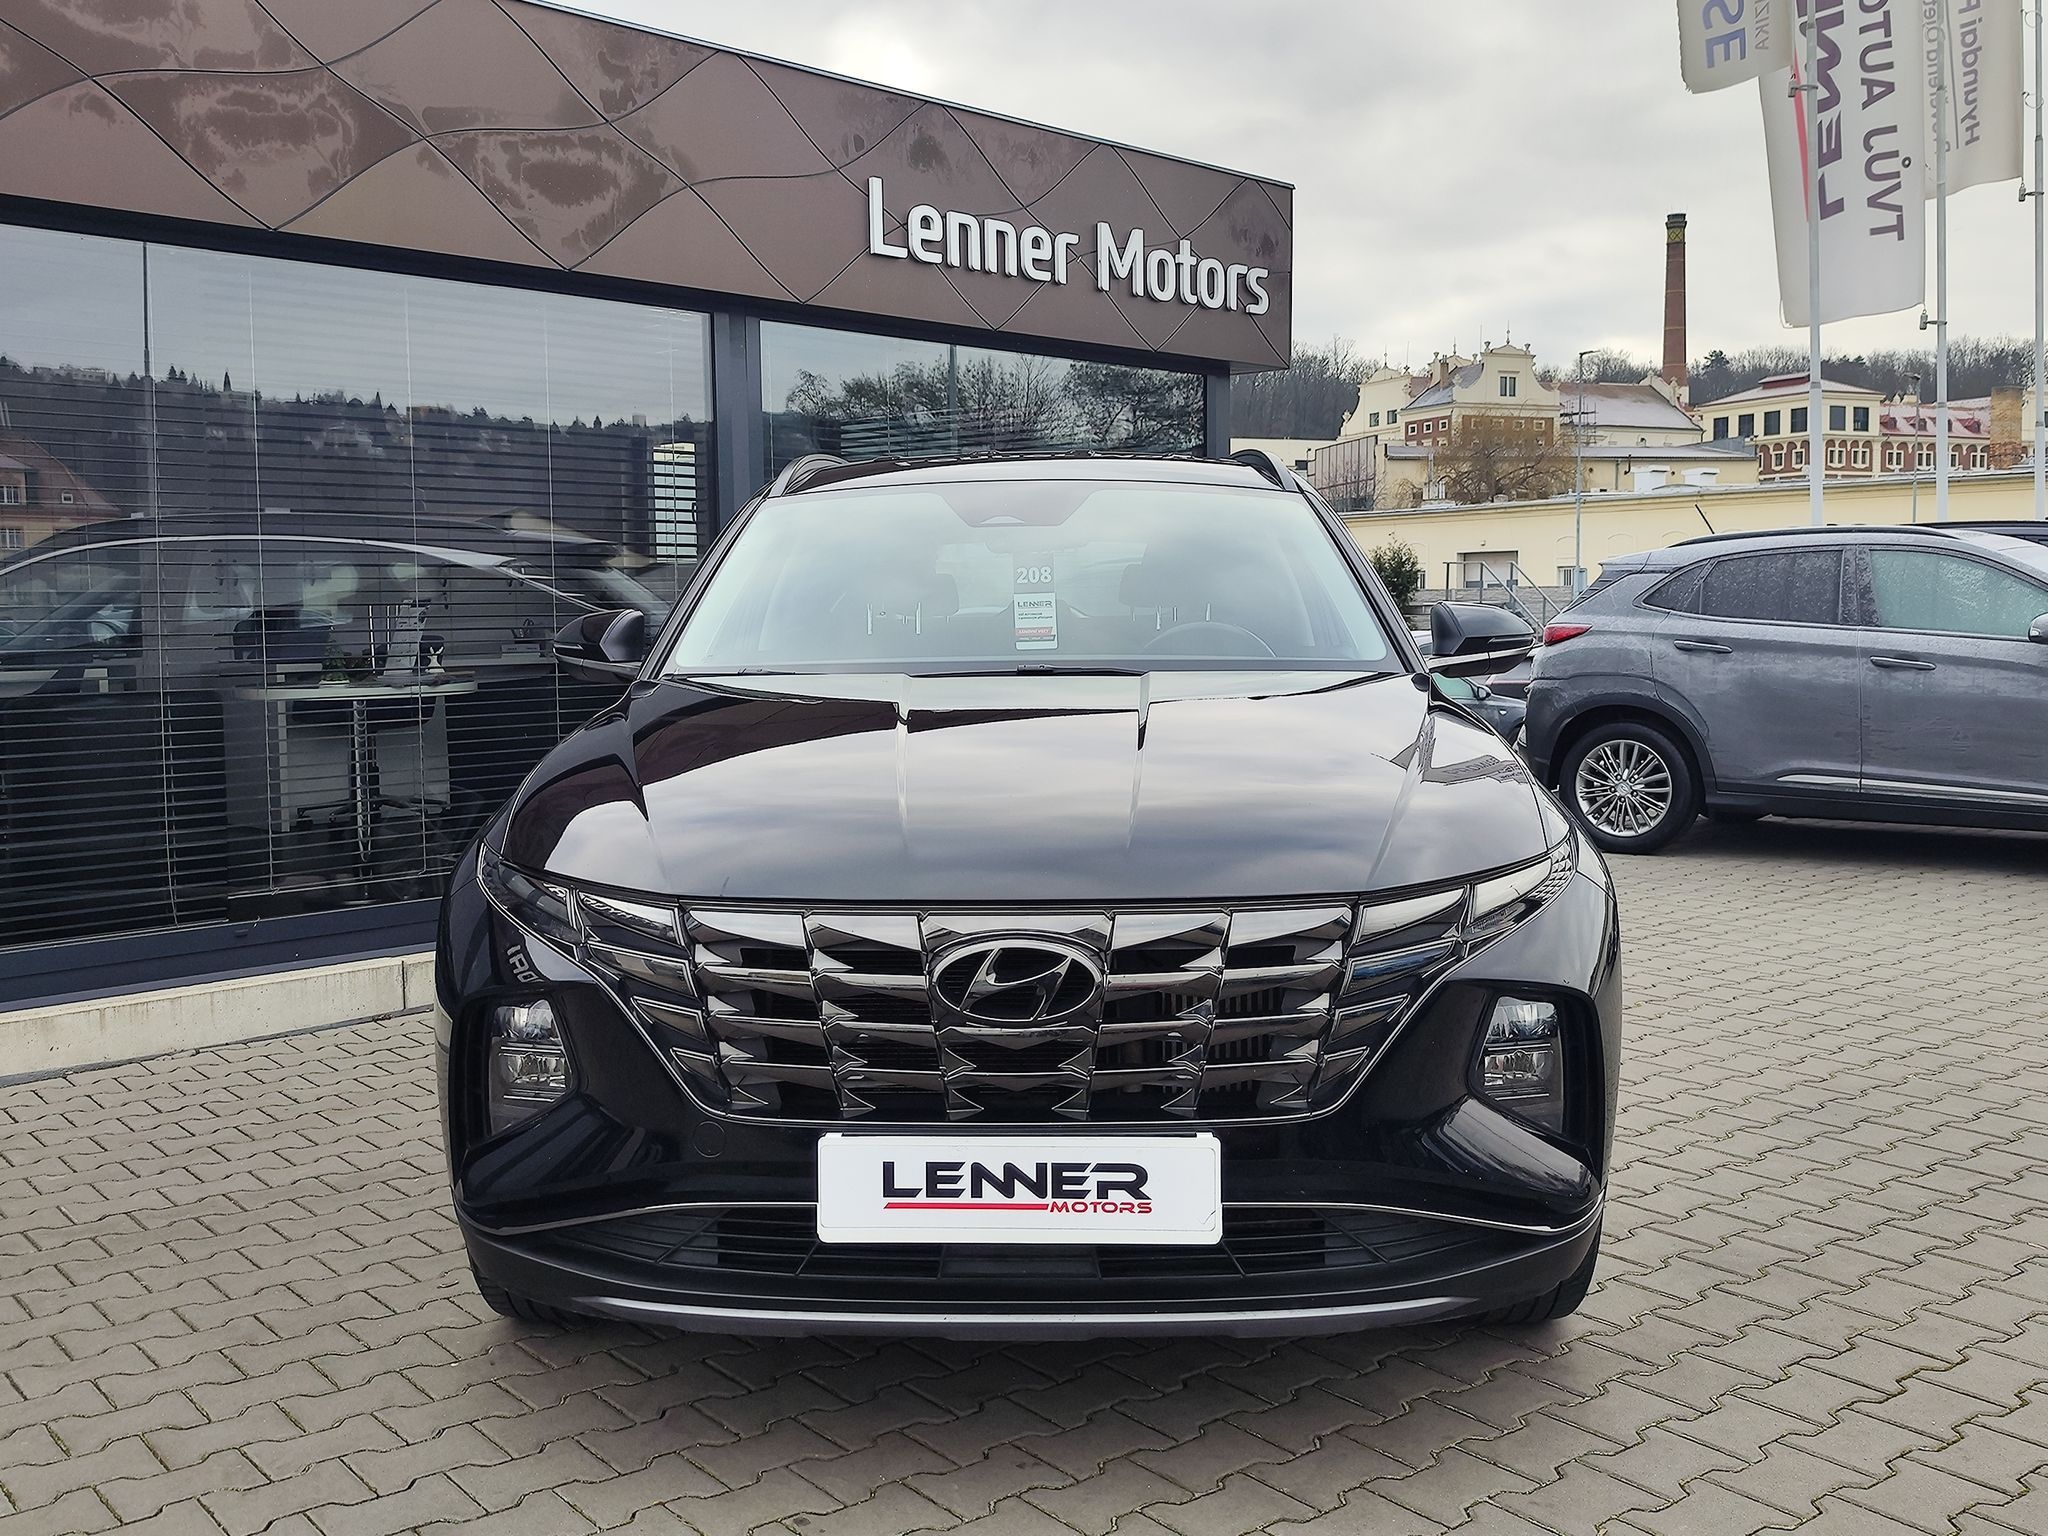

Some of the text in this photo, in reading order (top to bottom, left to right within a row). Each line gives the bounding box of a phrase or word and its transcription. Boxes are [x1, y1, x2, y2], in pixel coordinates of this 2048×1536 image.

[867, 176, 1271, 316] Lenner Motors
[1016, 566, 1053, 584] 208
[882, 1161, 1152, 1200] LENNER
[1048, 1201, 1153, 1214] MOTORS
